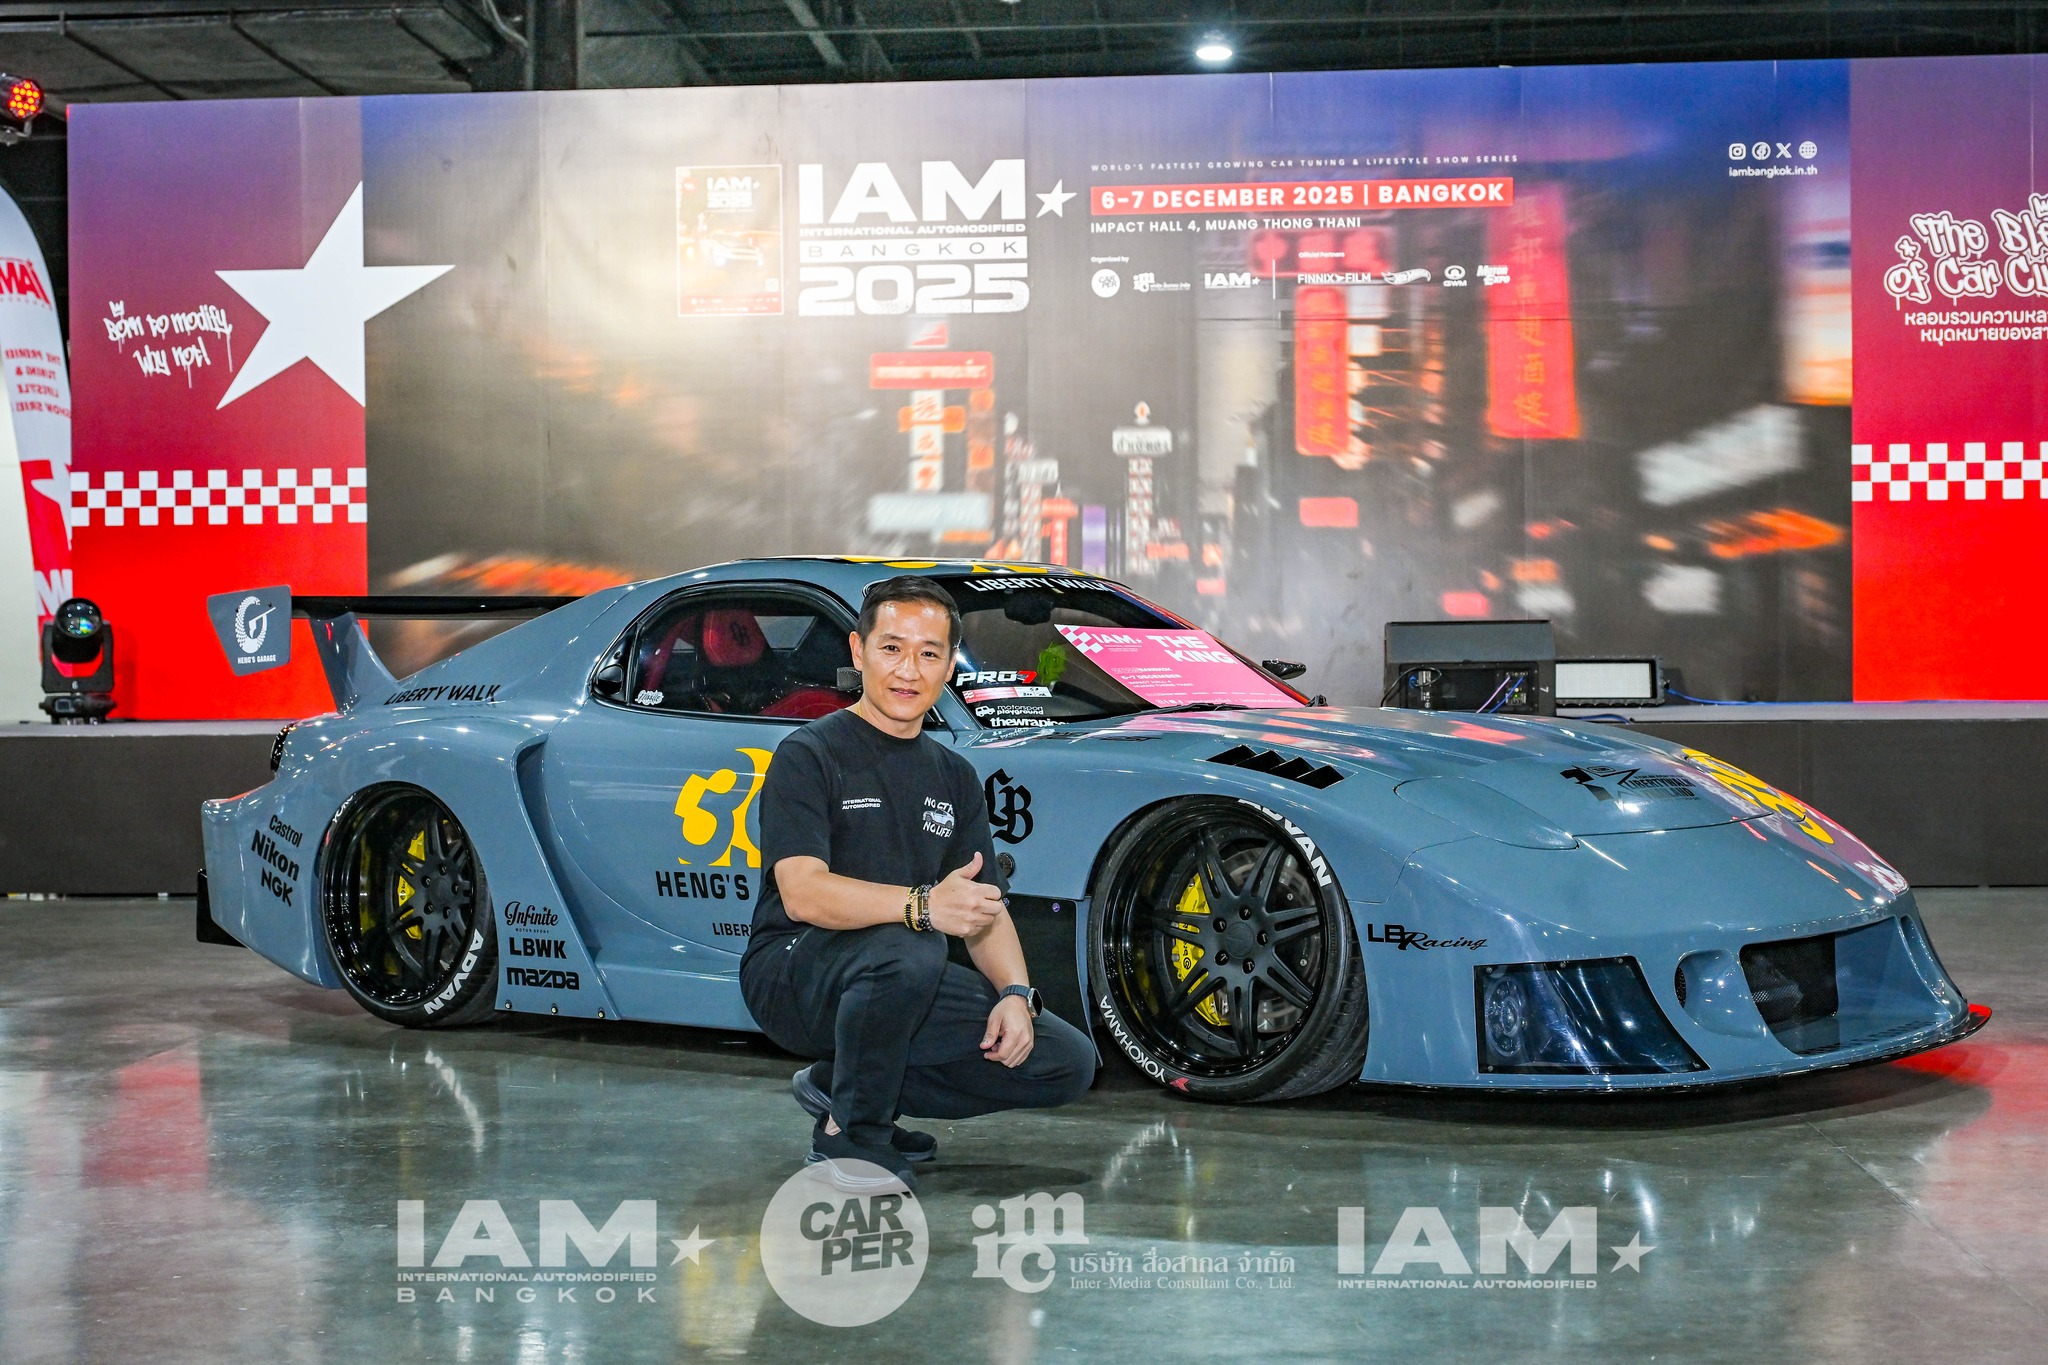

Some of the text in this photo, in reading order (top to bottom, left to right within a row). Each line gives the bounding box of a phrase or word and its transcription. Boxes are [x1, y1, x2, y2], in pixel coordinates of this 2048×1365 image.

[1091, 154, 1518, 171] WORLD'S FASTEST GROWING CAR TUNING & LIFESTYLE SHOW SERIES
[1729, 164, 1818, 178] iambangkok.in.th
[707, 176, 752, 190] IAM
[799, 158, 1026, 224] IAM
[1101, 183, 1504, 209] 6-7 DECEMBER 2025 BANGKOK
[800, 223, 1026, 238] INTERNATIONAL AUTOMODIFIED
[1091, 216, 1361, 233] IMPACT HALL 4, MUANG THONG THANI
[808, 241, 1018, 257] BANGKOK
[1204, 272, 1251, 286] IAM
[1298, 272, 1334, 284] FINNIX
[1346, 272, 1371, 283] FILM
[1934, 256, 2003, 298] Car
[798, 262, 1030, 317] 2025
[963, 577, 1116, 593] LIBERTY WALK
[1091, 633, 1209, 649] IAM THE
[1164, 649, 1239, 664] KING
[956, 670, 1037, 687] PRO7
[384, 684, 501, 705] LIBERTY WALK
[269, 814, 303, 848] Castrol
[251, 829, 300, 882] Nikon
[260, 866, 294, 908] NGK
[655, 870, 750, 901] HENG'S
[504, 901, 559, 926] Infinite
[509, 937, 568, 959] LBWK
[423, 928, 484, 1015] ADVAN
[1100, 995, 1166, 1083] YOKOHAMA
